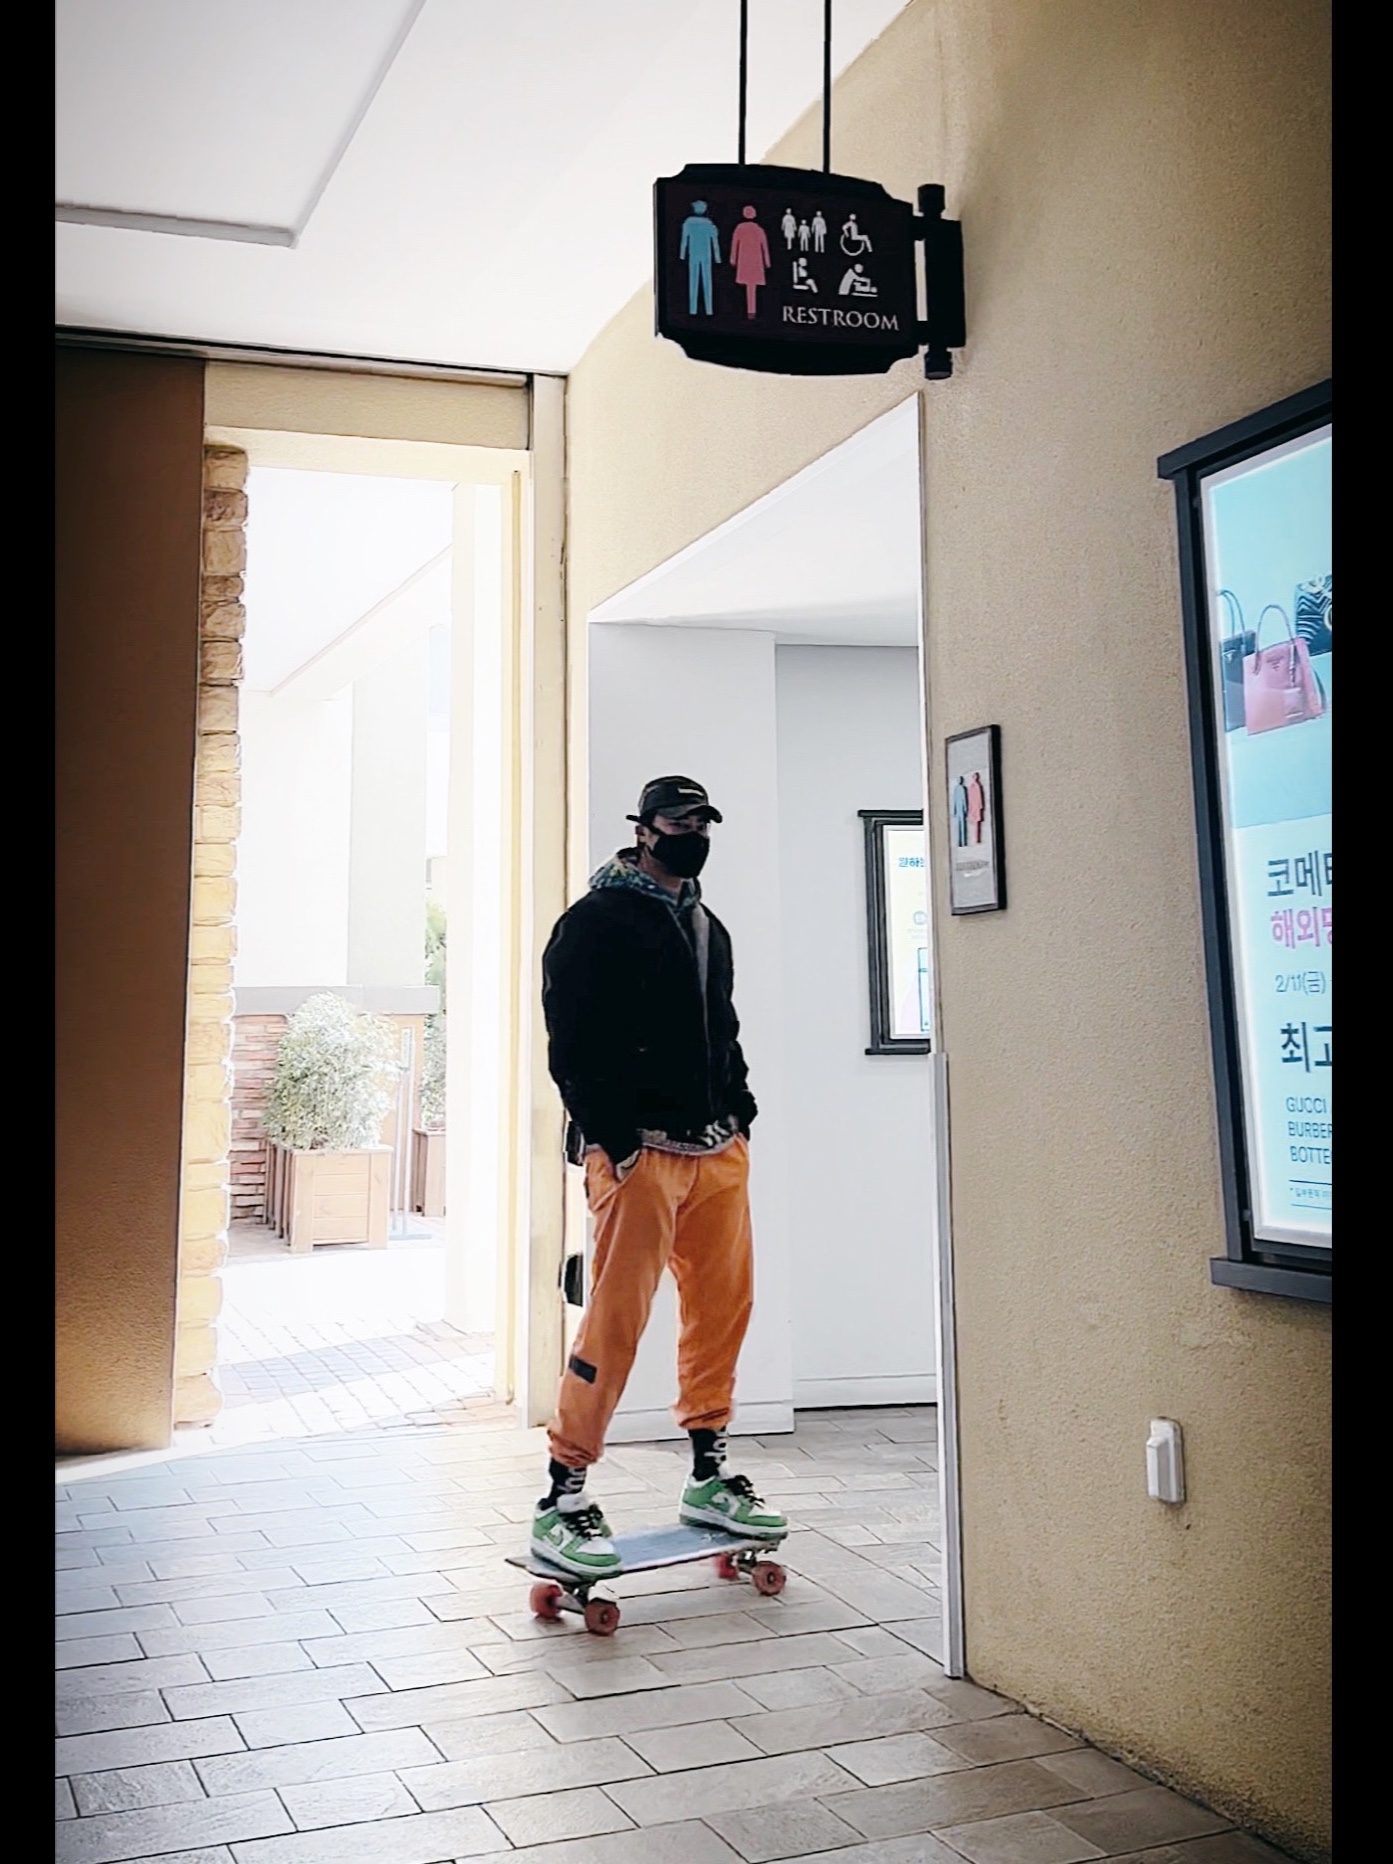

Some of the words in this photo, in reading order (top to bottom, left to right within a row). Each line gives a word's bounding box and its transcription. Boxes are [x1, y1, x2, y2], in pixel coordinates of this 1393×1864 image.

[782, 305, 900, 332] RESTROOM
[1286, 1097, 1327, 1113] GUCCI
[1290, 1146, 1332, 1164] BOTTE
